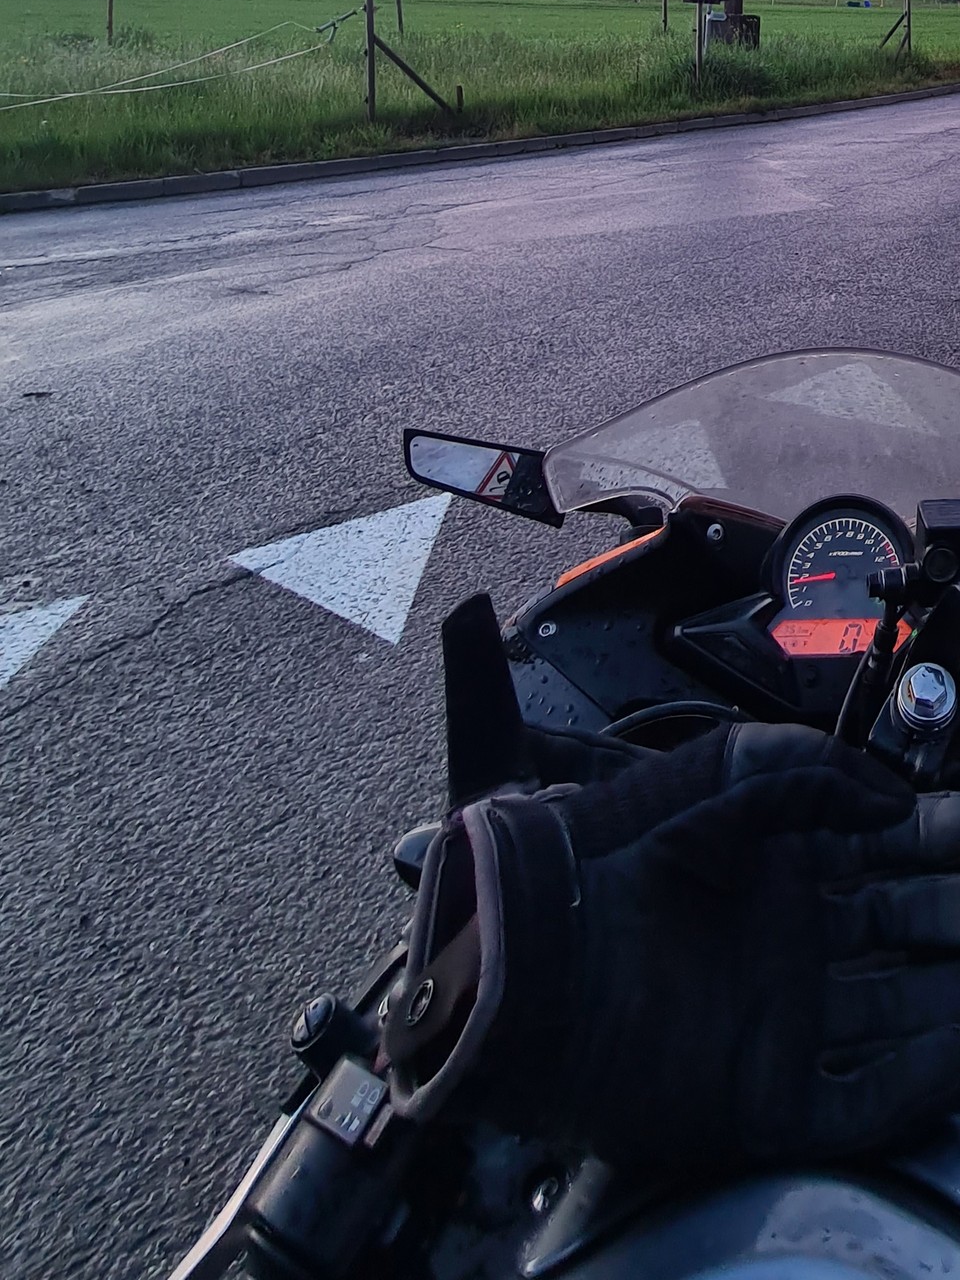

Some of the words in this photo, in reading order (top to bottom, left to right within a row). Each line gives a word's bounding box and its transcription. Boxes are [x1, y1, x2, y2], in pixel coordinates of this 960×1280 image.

[835, 531, 844, 539] 7
[814, 542, 823, 550] 5
[839, 623, 862, 652] 0
